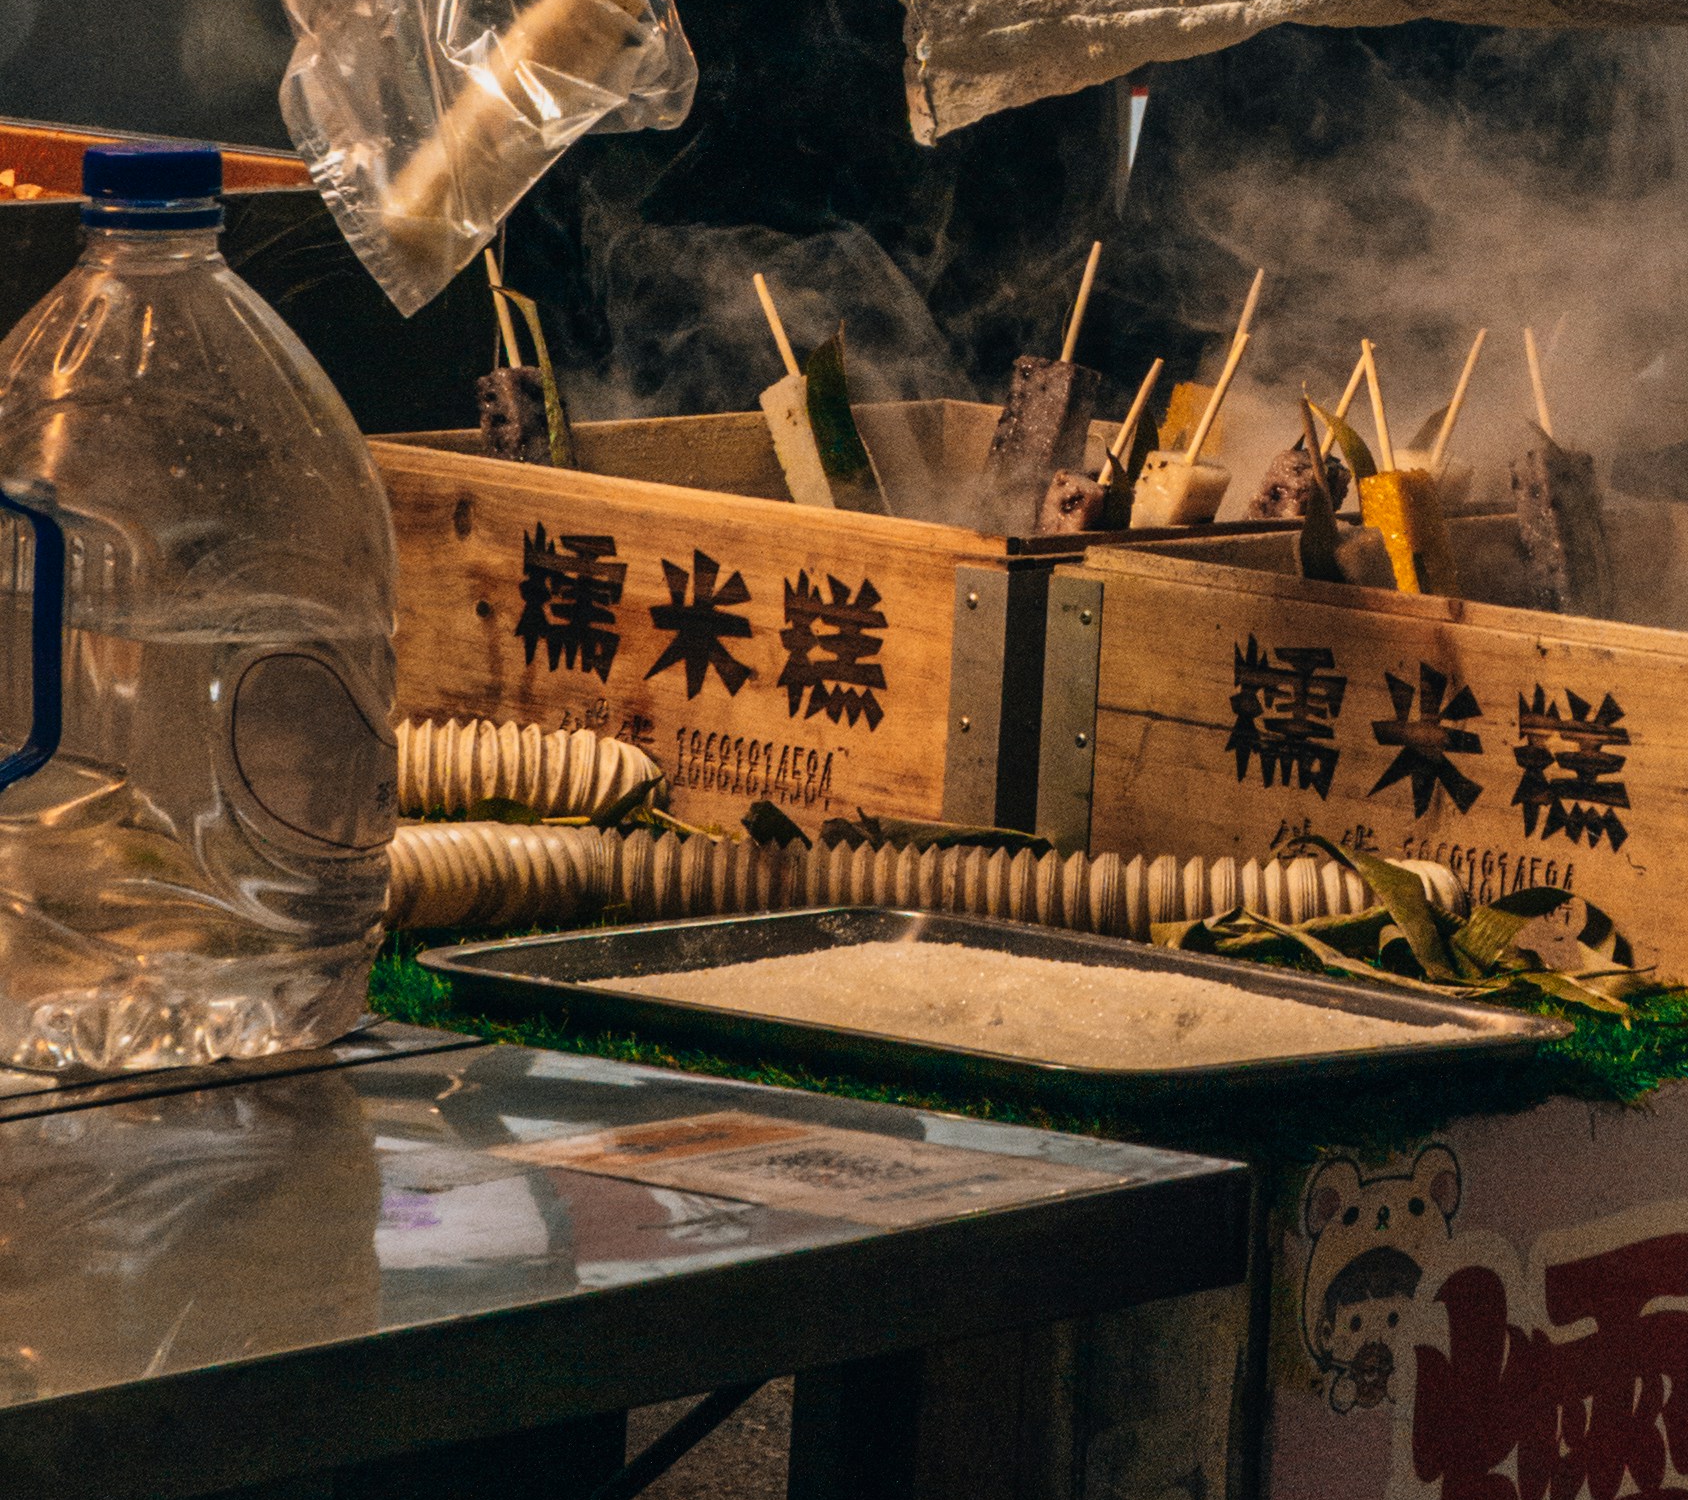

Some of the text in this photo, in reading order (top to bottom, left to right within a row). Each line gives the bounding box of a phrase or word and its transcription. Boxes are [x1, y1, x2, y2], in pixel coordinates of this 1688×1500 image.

[515, 520, 889, 733] 糯米糕
[1225, 631, 1632, 853] 糯米糕
